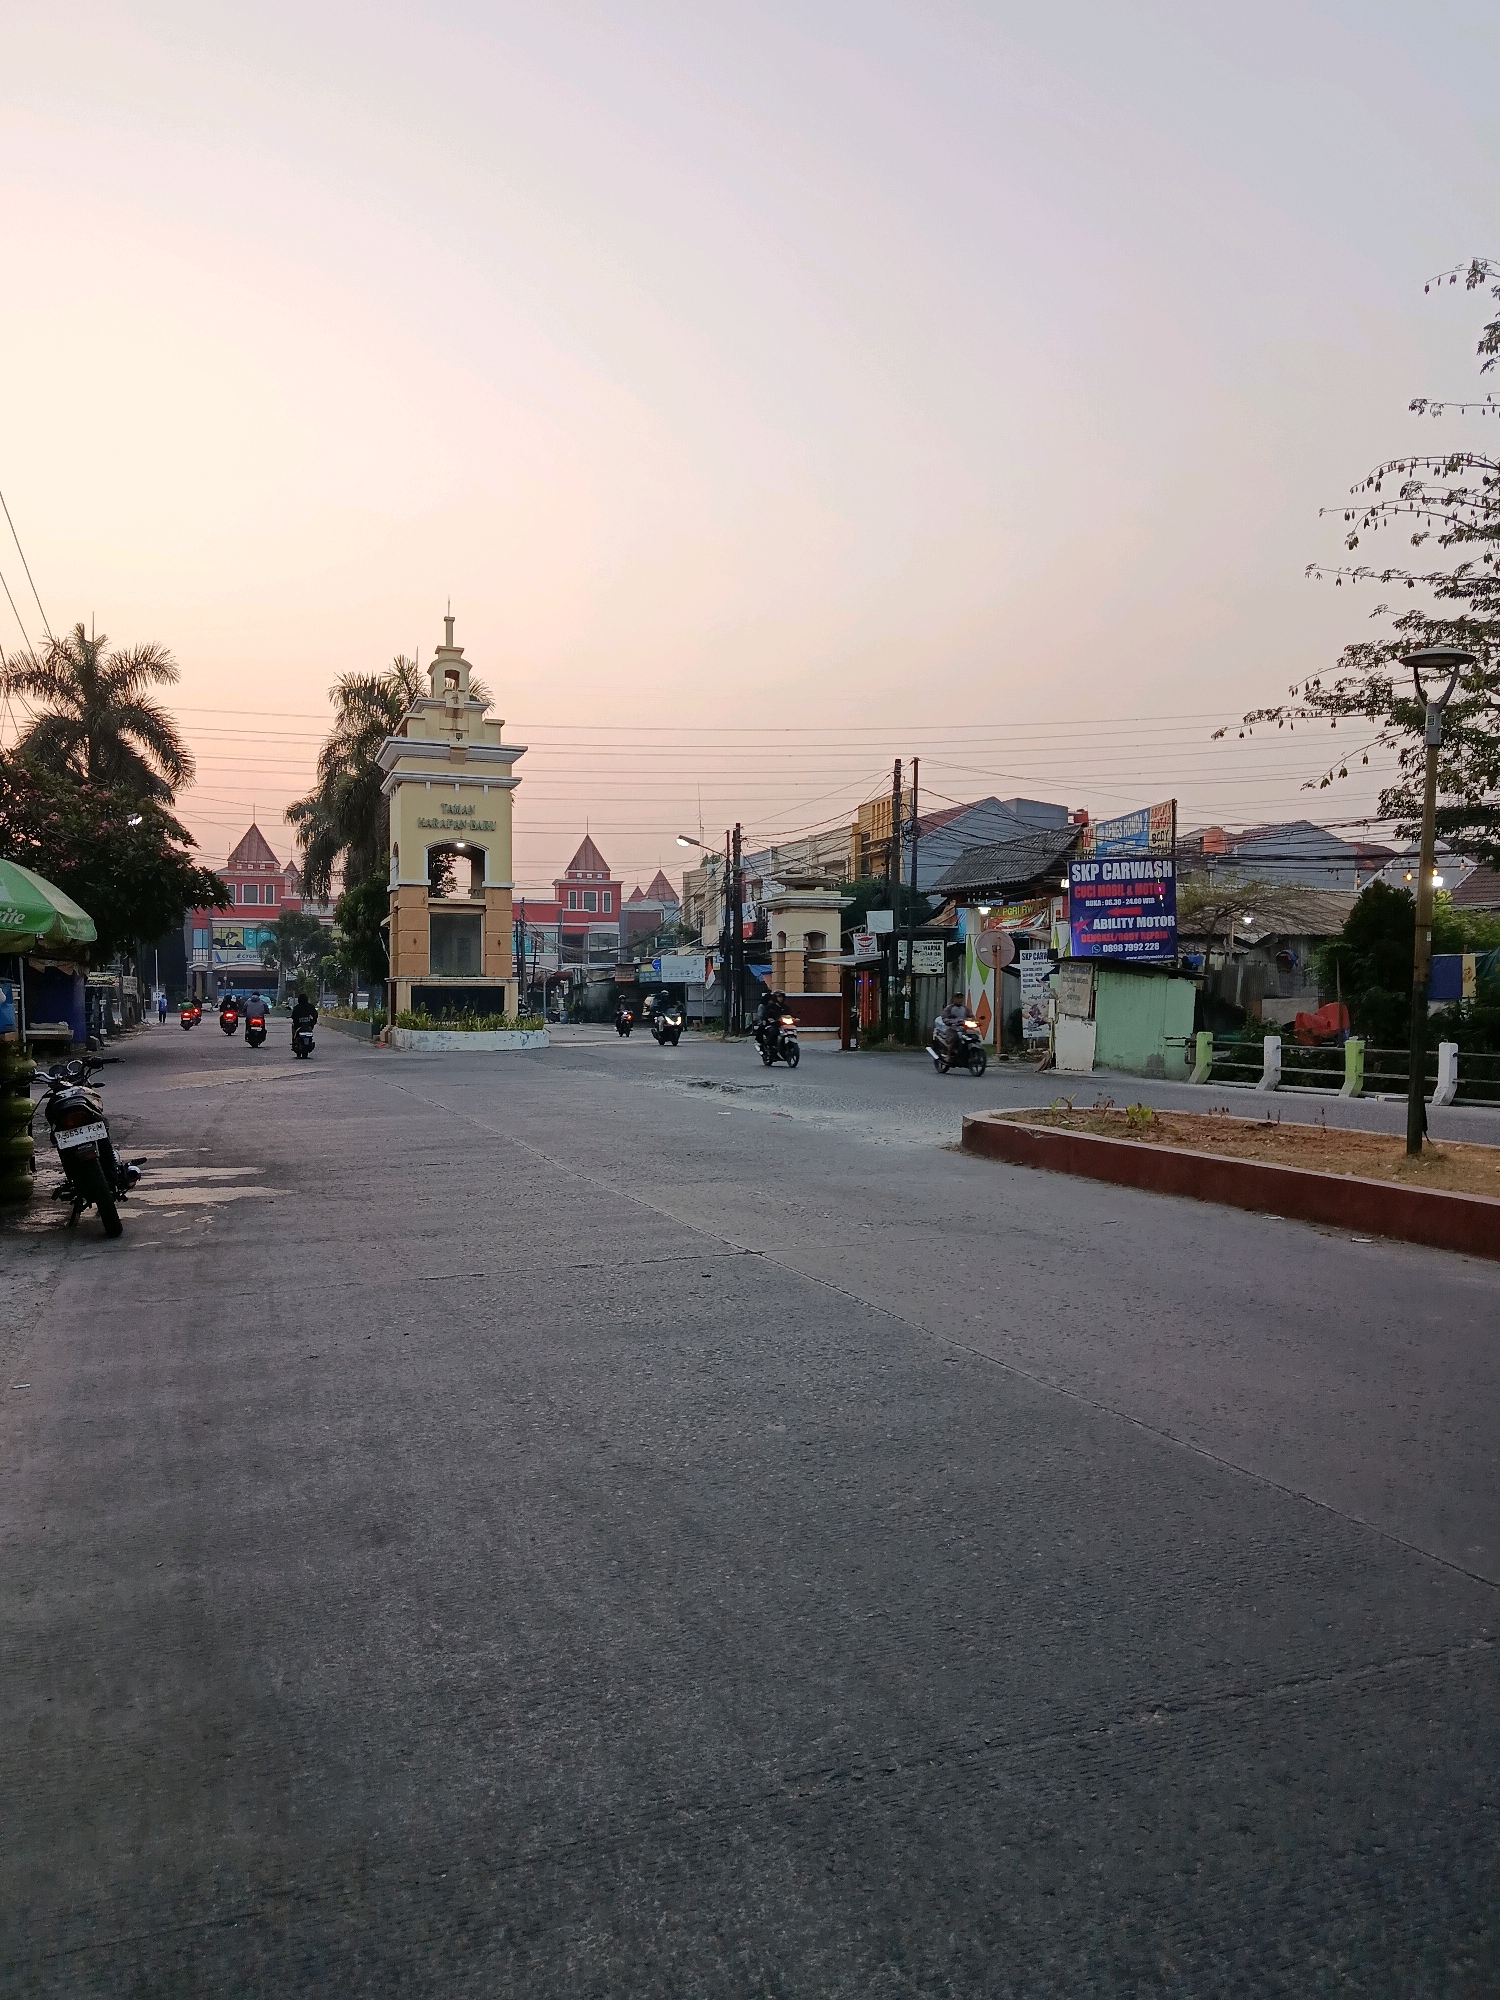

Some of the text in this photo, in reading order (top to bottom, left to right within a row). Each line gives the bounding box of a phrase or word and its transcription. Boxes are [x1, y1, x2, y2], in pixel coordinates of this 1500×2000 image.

[440, 803, 476, 815] TAMAN
[417, 817, 497, 832] HARAPAN BARU
[1072, 860, 1173, 882] SKP CARWASH
[1074, 885, 1096, 898] CUCI
[1098, 884, 1125, 897] MOBIL
[1127, 886, 1133, 896] &
[1086, 899, 1101, 907] BUKA
[1003, 907, 1019, 916] PGRI
[1093, 915, 1175, 930] ABILITY MOTOR
[1103, 942, 1159, 952] 0898 7992 228
[1021, 952, 1032, 961] SKP
